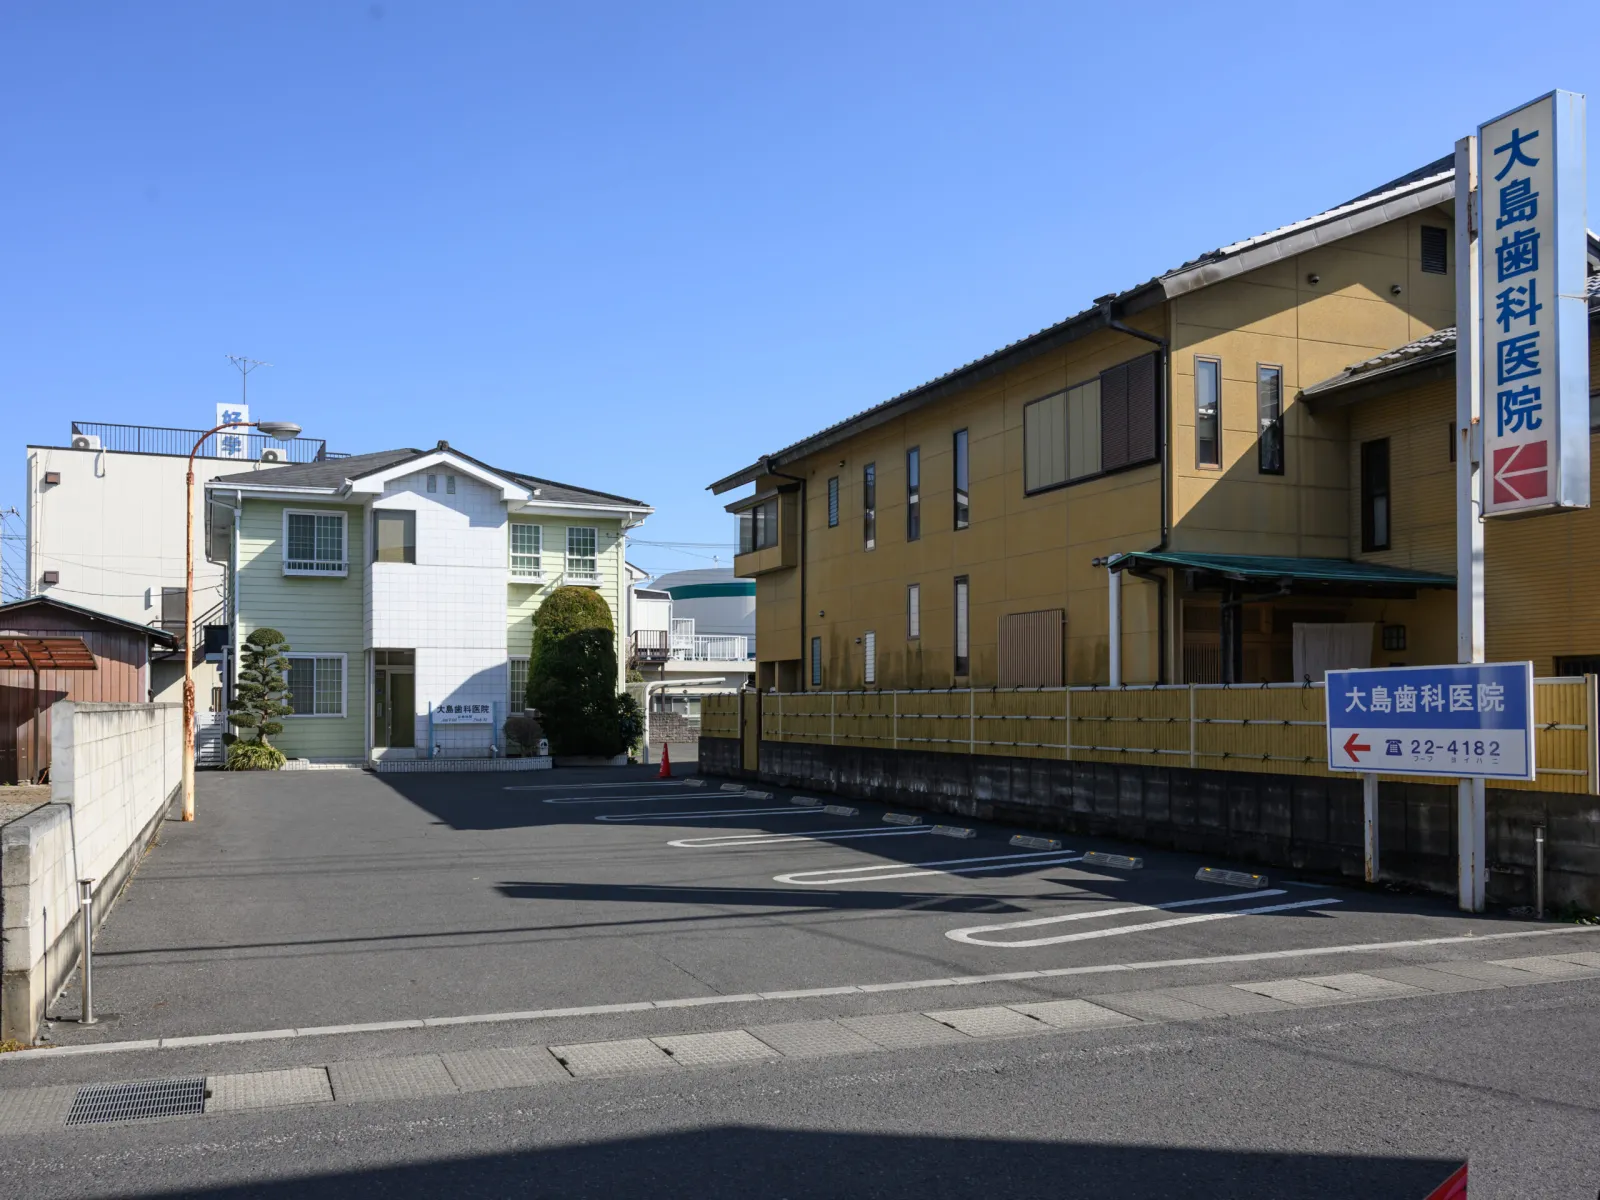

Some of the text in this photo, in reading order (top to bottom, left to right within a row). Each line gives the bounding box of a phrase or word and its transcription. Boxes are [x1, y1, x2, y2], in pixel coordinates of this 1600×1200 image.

[1493, 127, 1543, 438] 大島歯科医院
[437, 704, 490, 714] 大島歯科医院
[1345, 682, 1505, 713] 大島歯科医院
[1411, 739, 1500, 757] 22-4182
